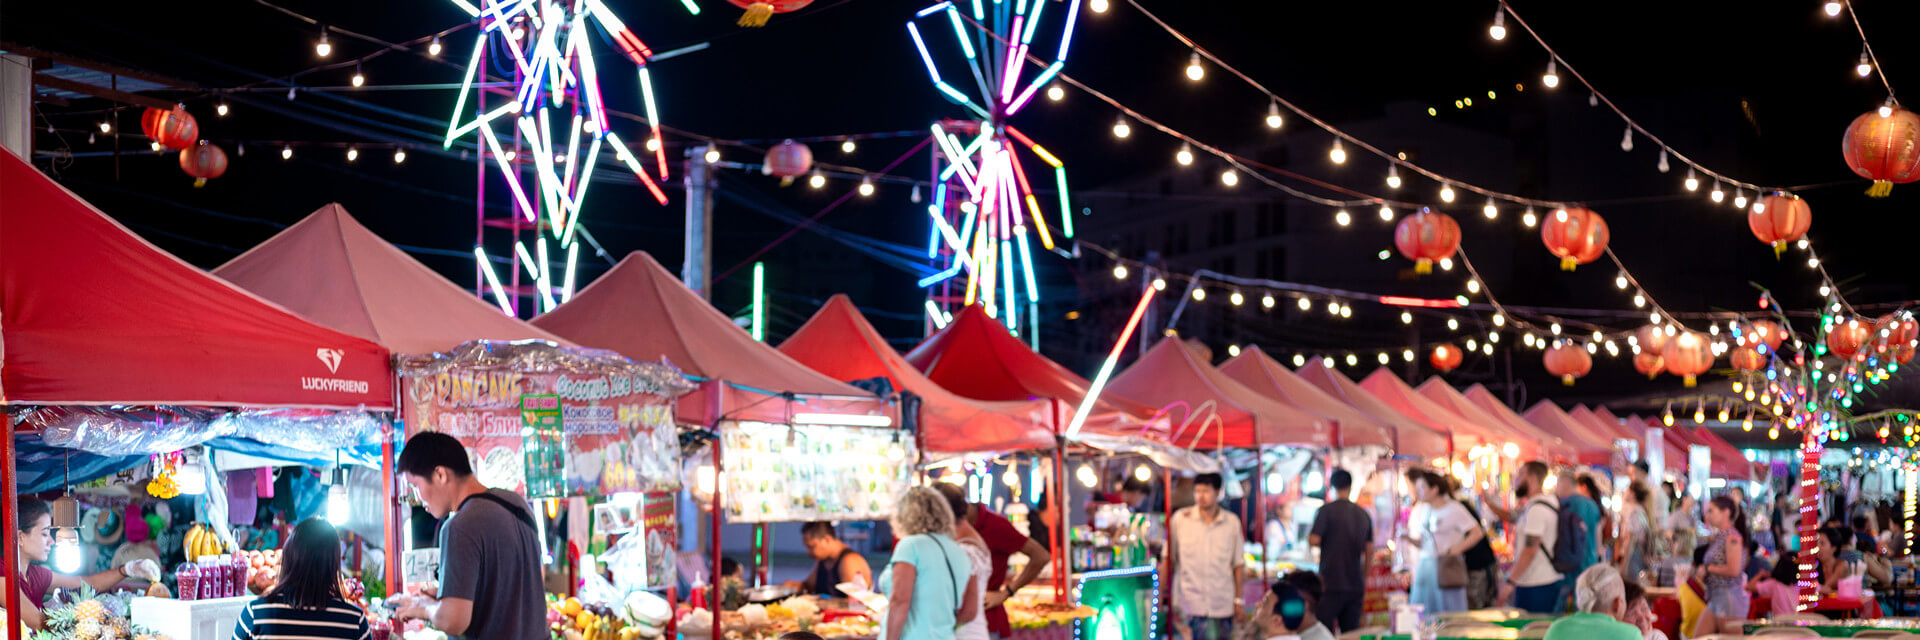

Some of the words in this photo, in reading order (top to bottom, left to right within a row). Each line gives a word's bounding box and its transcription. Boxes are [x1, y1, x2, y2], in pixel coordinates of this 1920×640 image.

[302, 376, 369, 394] LUCKYFRIEND
[437, 371, 523, 408] PANCAKE
[557, 374, 609, 400] Coconut
[610, 375, 631, 397] Ice
[605, 461, 624, 490] 60
